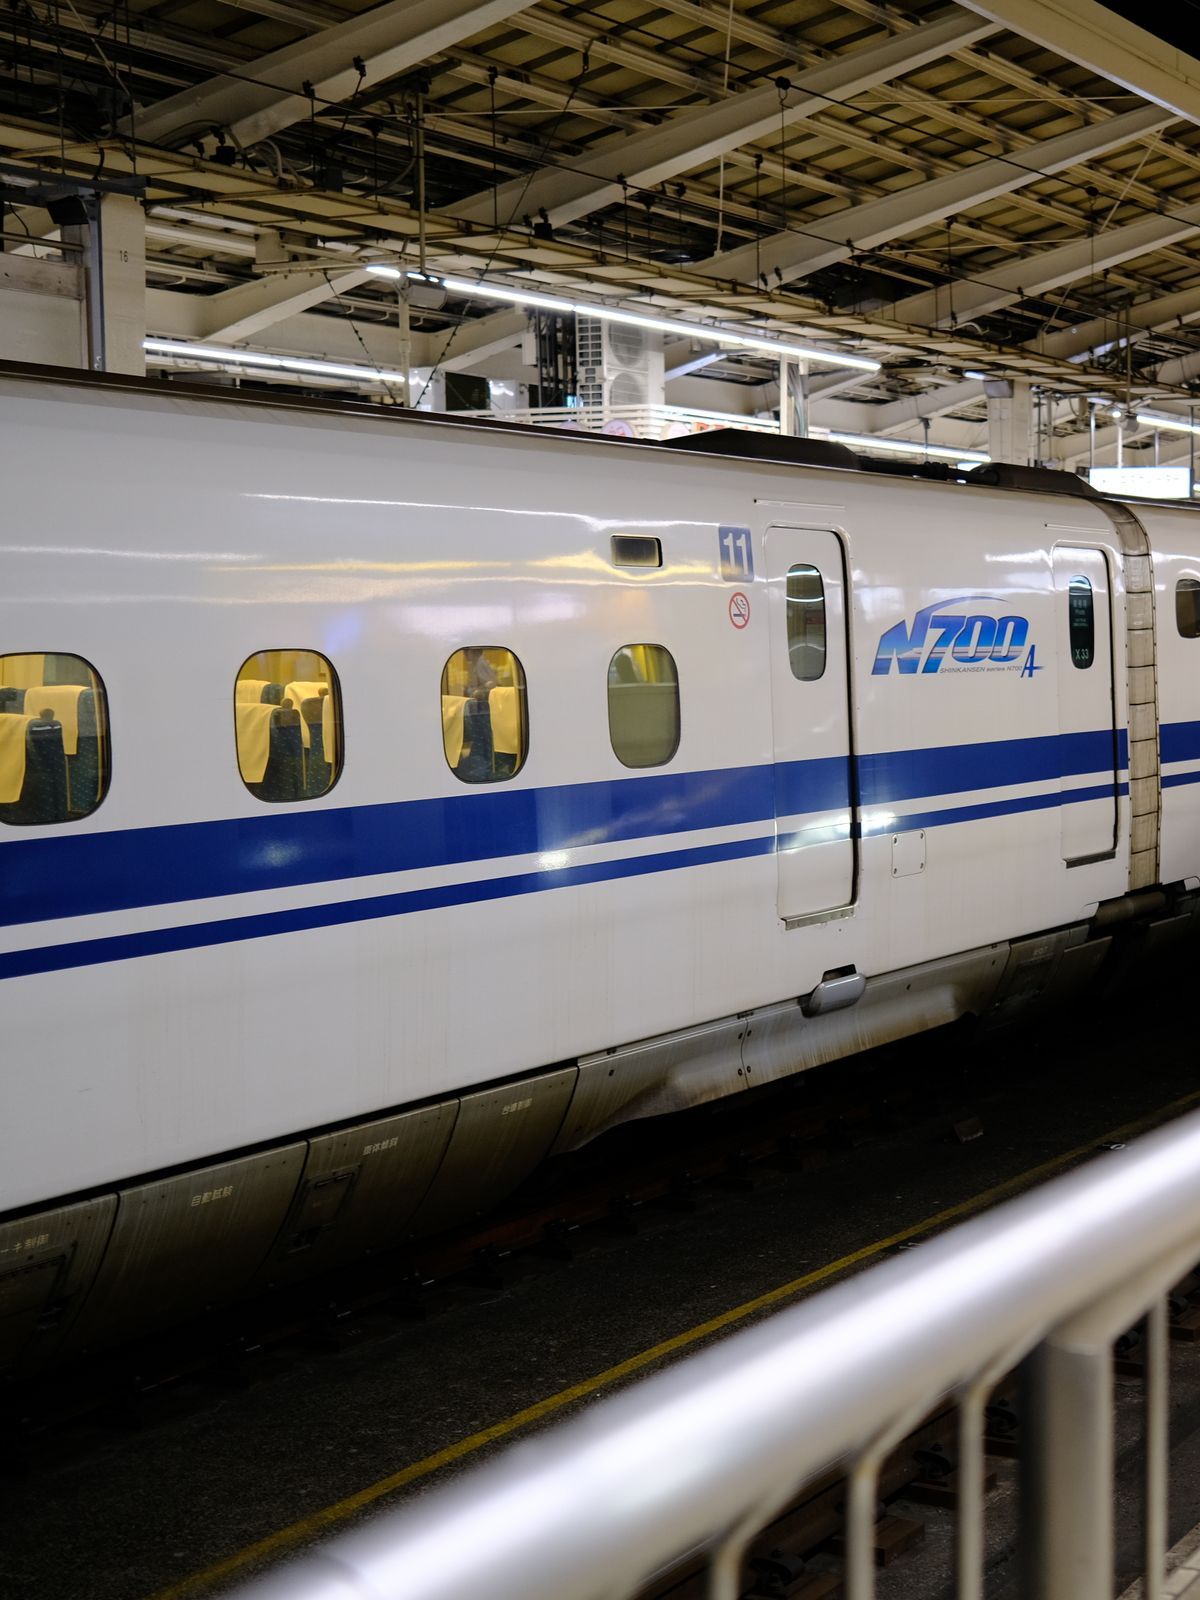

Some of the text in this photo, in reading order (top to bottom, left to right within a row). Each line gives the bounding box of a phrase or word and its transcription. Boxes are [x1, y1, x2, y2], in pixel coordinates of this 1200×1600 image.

[119, 250, 129, 263] 16
[723, 532, 749, 576] 11
[871, 596, 1044, 678] N700 A
[939, 666, 985, 674] SHINKANSEN
